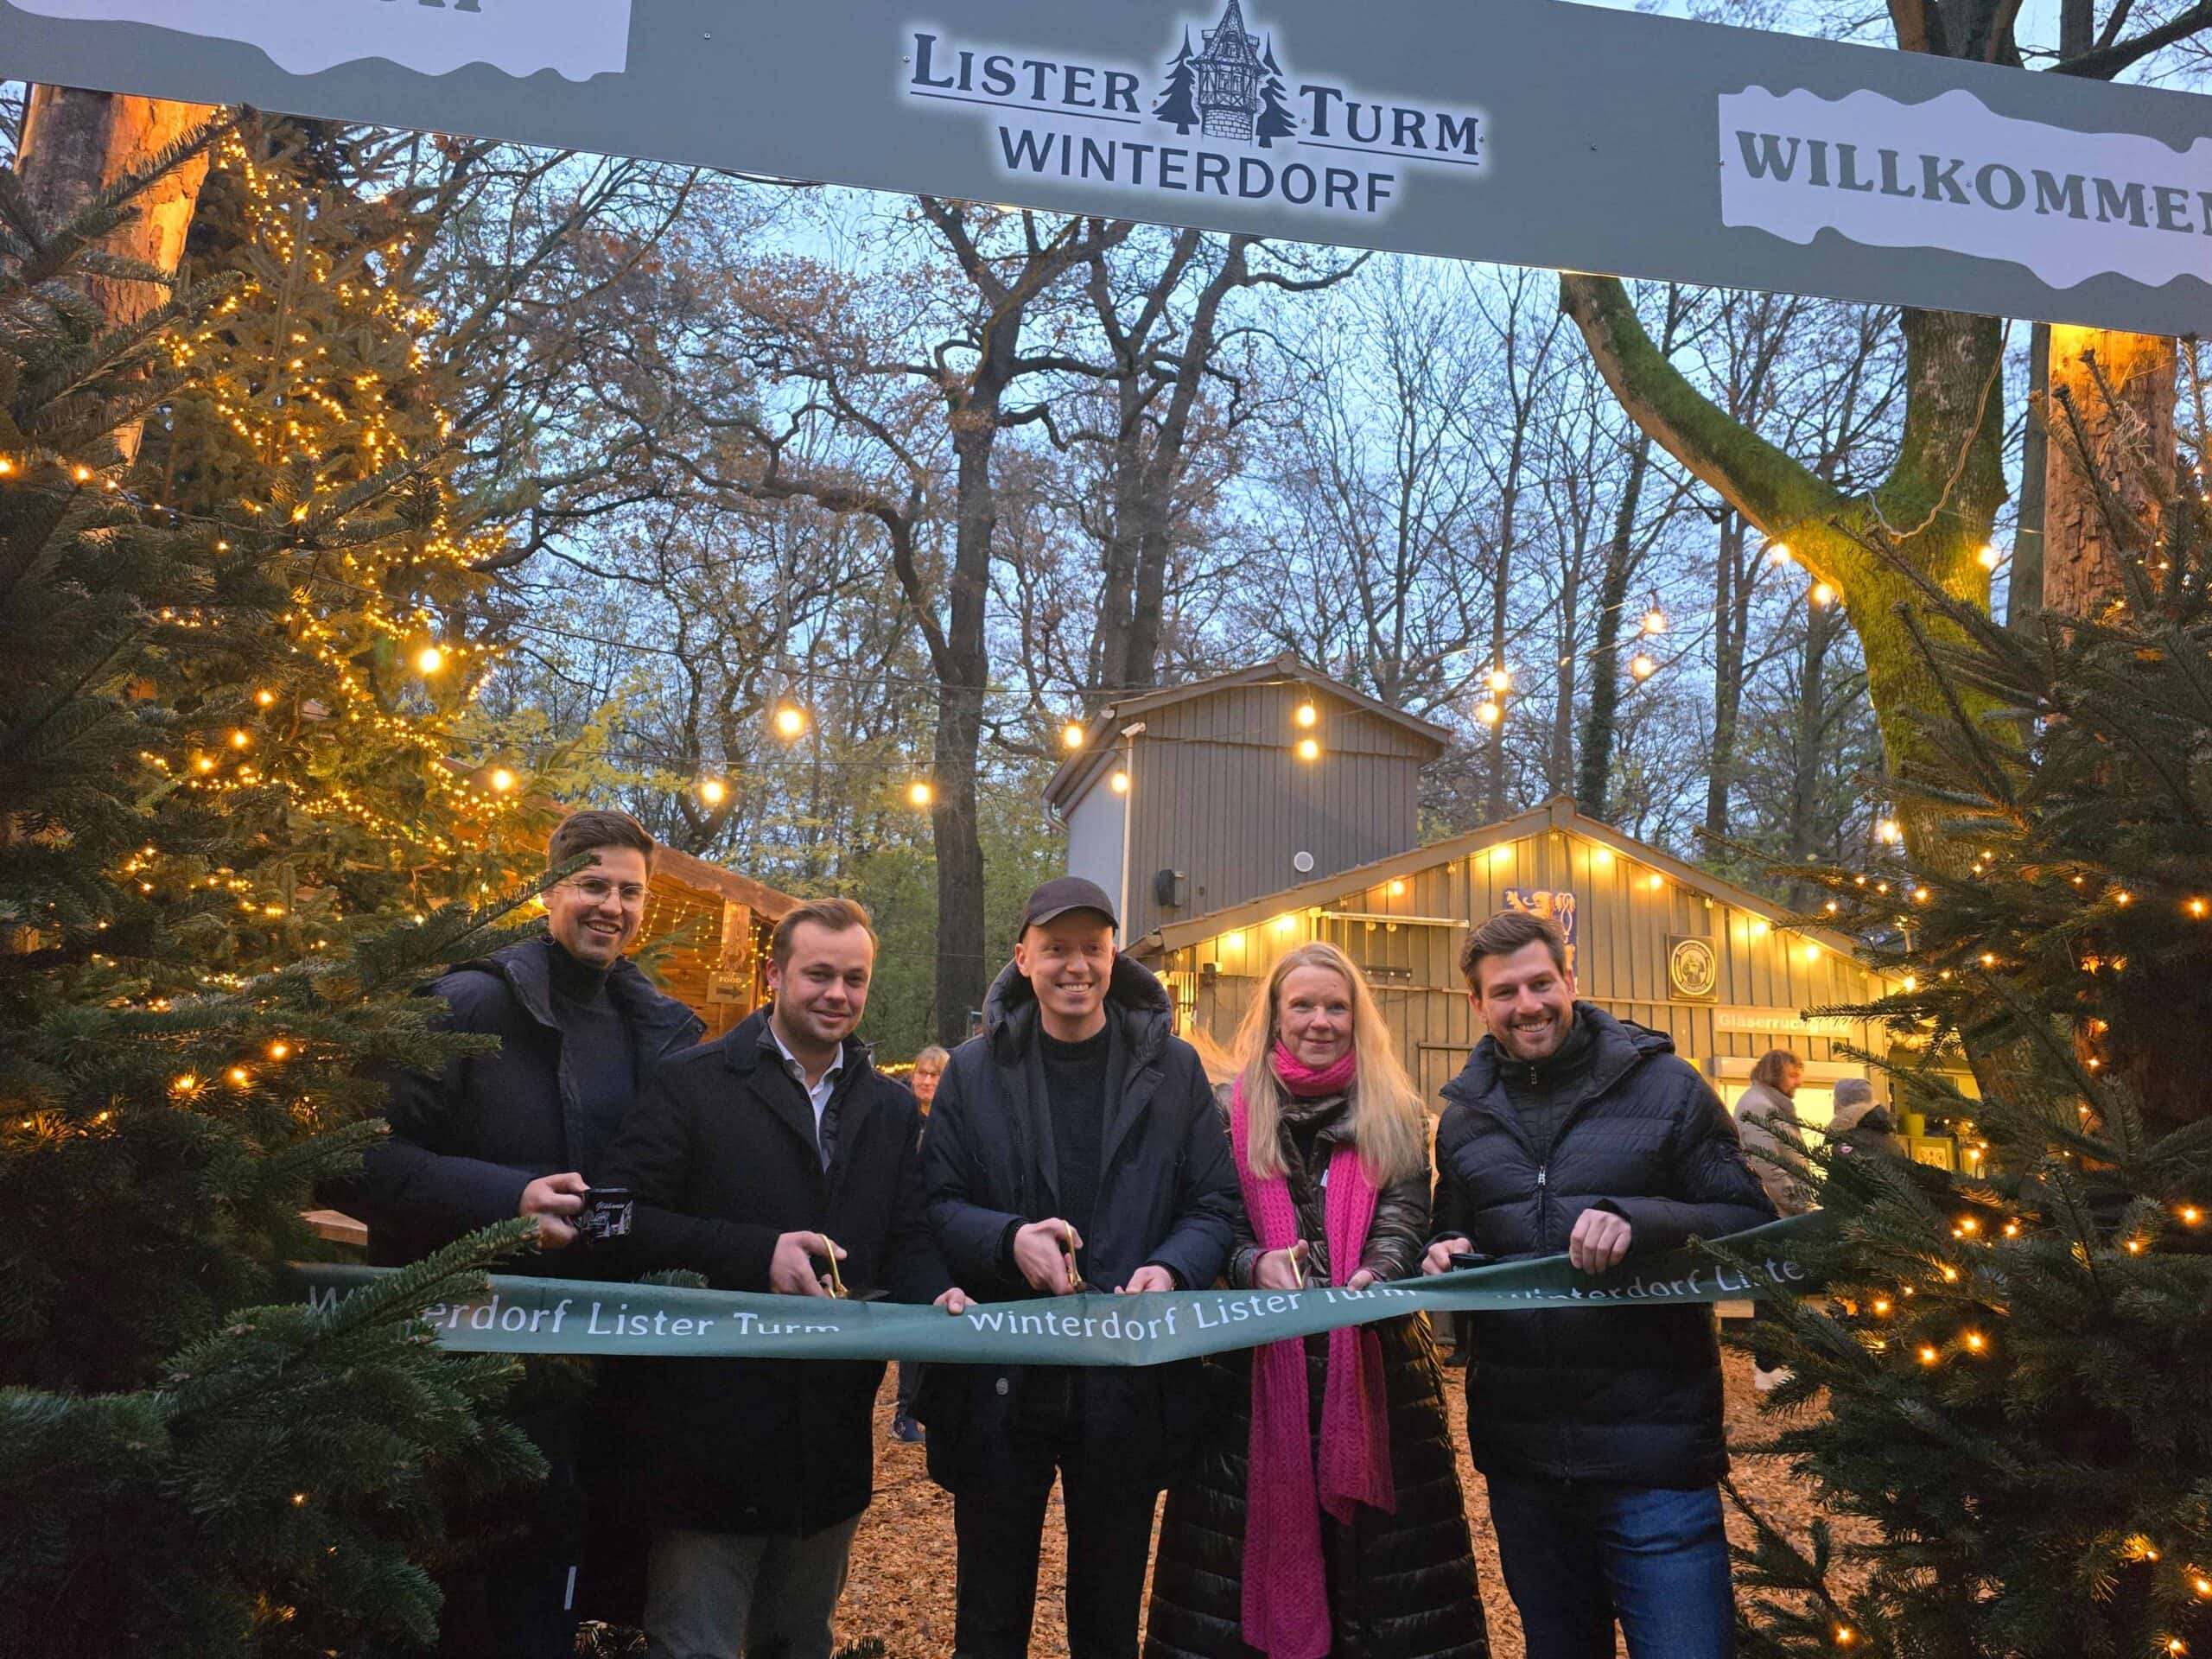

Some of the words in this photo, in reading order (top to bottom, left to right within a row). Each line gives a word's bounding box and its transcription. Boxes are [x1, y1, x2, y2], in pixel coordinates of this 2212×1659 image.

[911, 34, 1141, 113] LISTER
[1300, 85, 1478, 156] TURM
[1000, 126, 1395, 213] WINTERDORF
[308, 1285, 573, 1333] Werdorf
[588, 1302, 715, 1335] Lister
[734, 1313, 839, 1334] Turm
[968, 1307, 1177, 1340] Winterdorf
[1193, 1294, 1301, 1328] Lister
